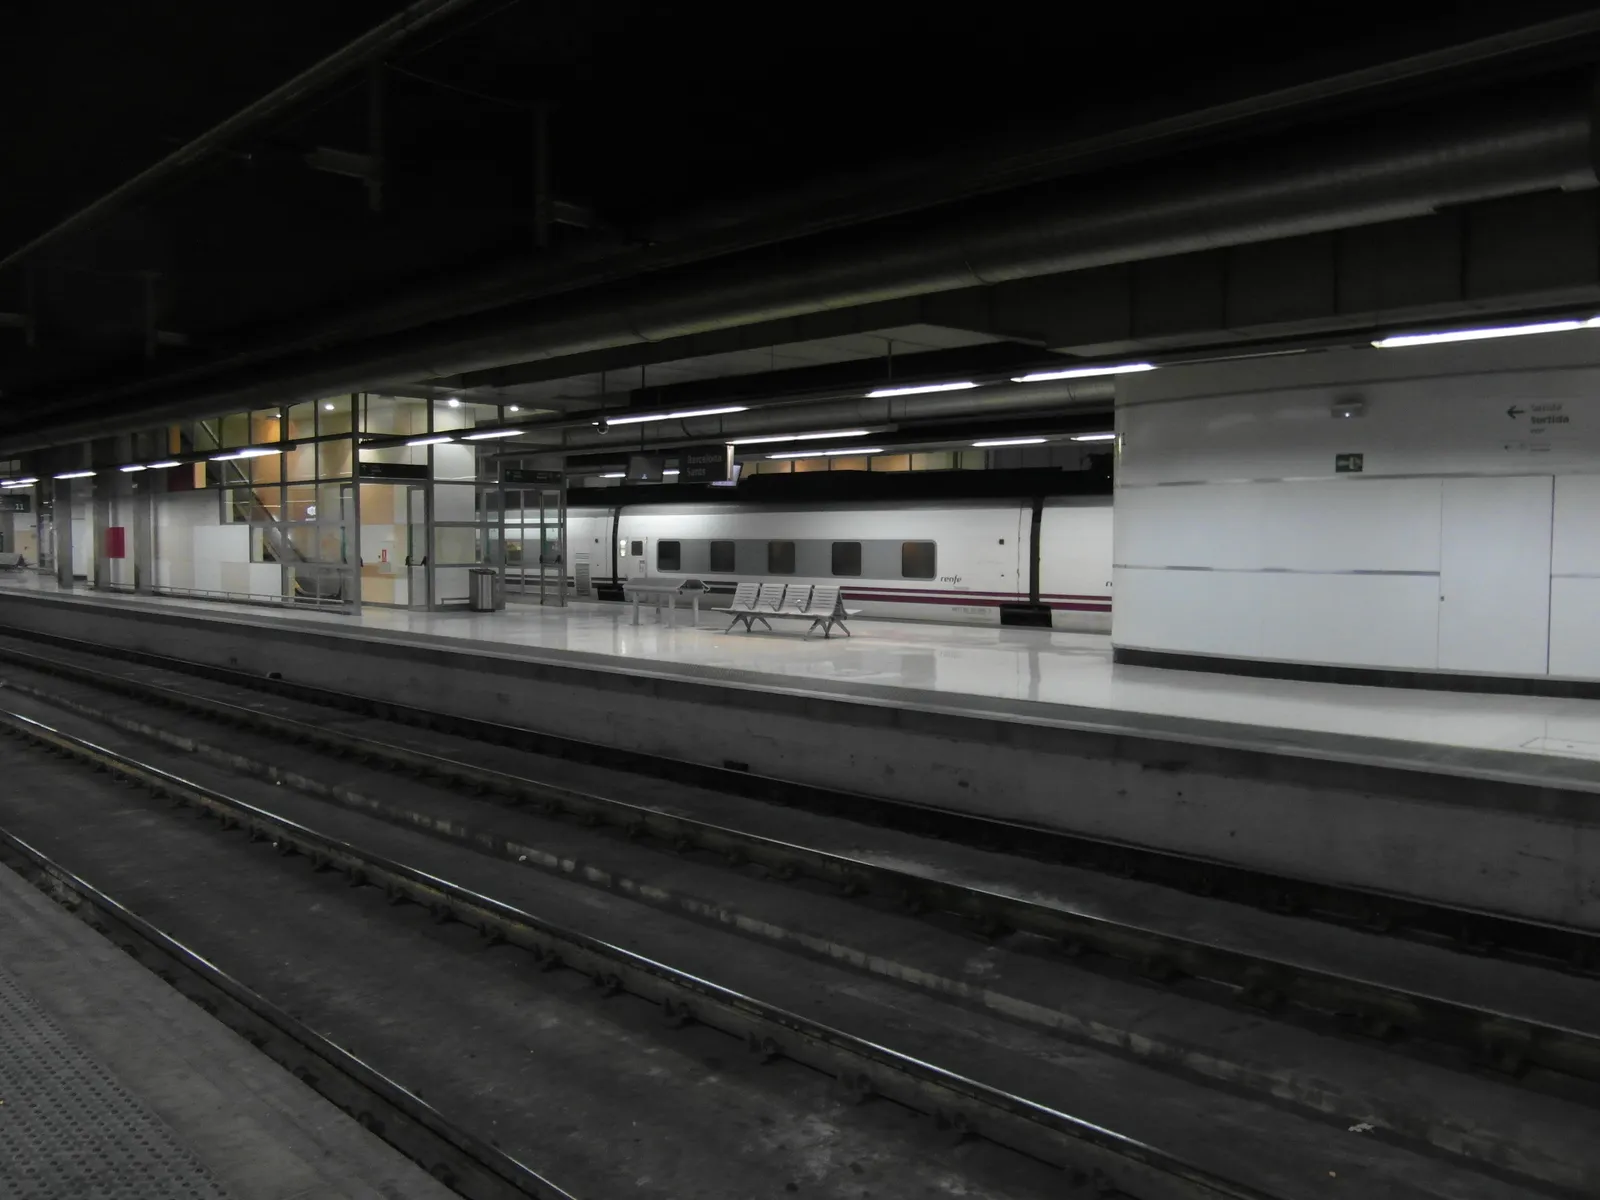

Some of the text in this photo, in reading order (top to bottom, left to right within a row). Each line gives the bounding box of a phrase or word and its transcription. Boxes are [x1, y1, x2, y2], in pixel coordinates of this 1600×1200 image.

[1530, 415, 1570, 424] Sortida
[687, 454, 722, 464] Barcelona
[15, 503, 24, 511] 11
[941, 574, 962, 586] renfe
